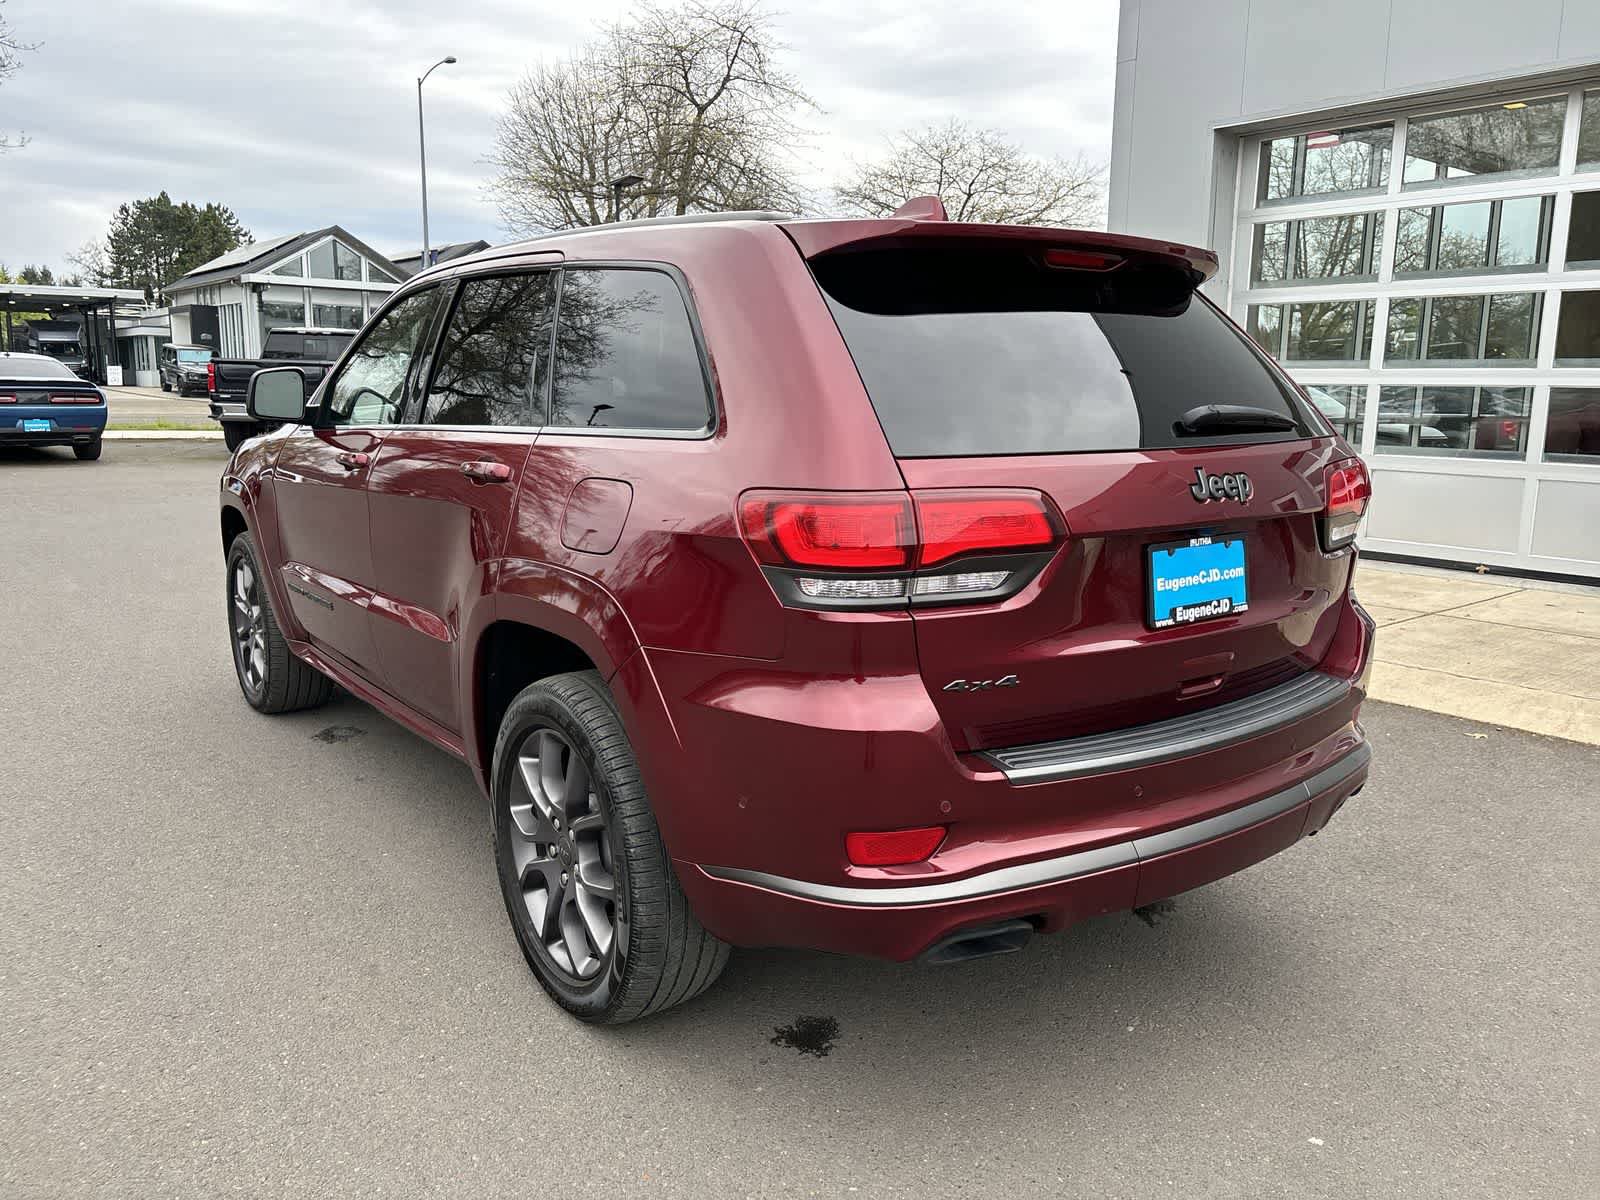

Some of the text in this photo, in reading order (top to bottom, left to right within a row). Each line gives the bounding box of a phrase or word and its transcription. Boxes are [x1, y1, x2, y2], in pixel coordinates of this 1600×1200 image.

[1188, 466, 1254, 505] Jeep
[1156, 566, 1245, 592] EugeneCJD.com
[1176, 598, 1230, 622] EugeneCJD
[942, 674, 1020, 692] 4x4
